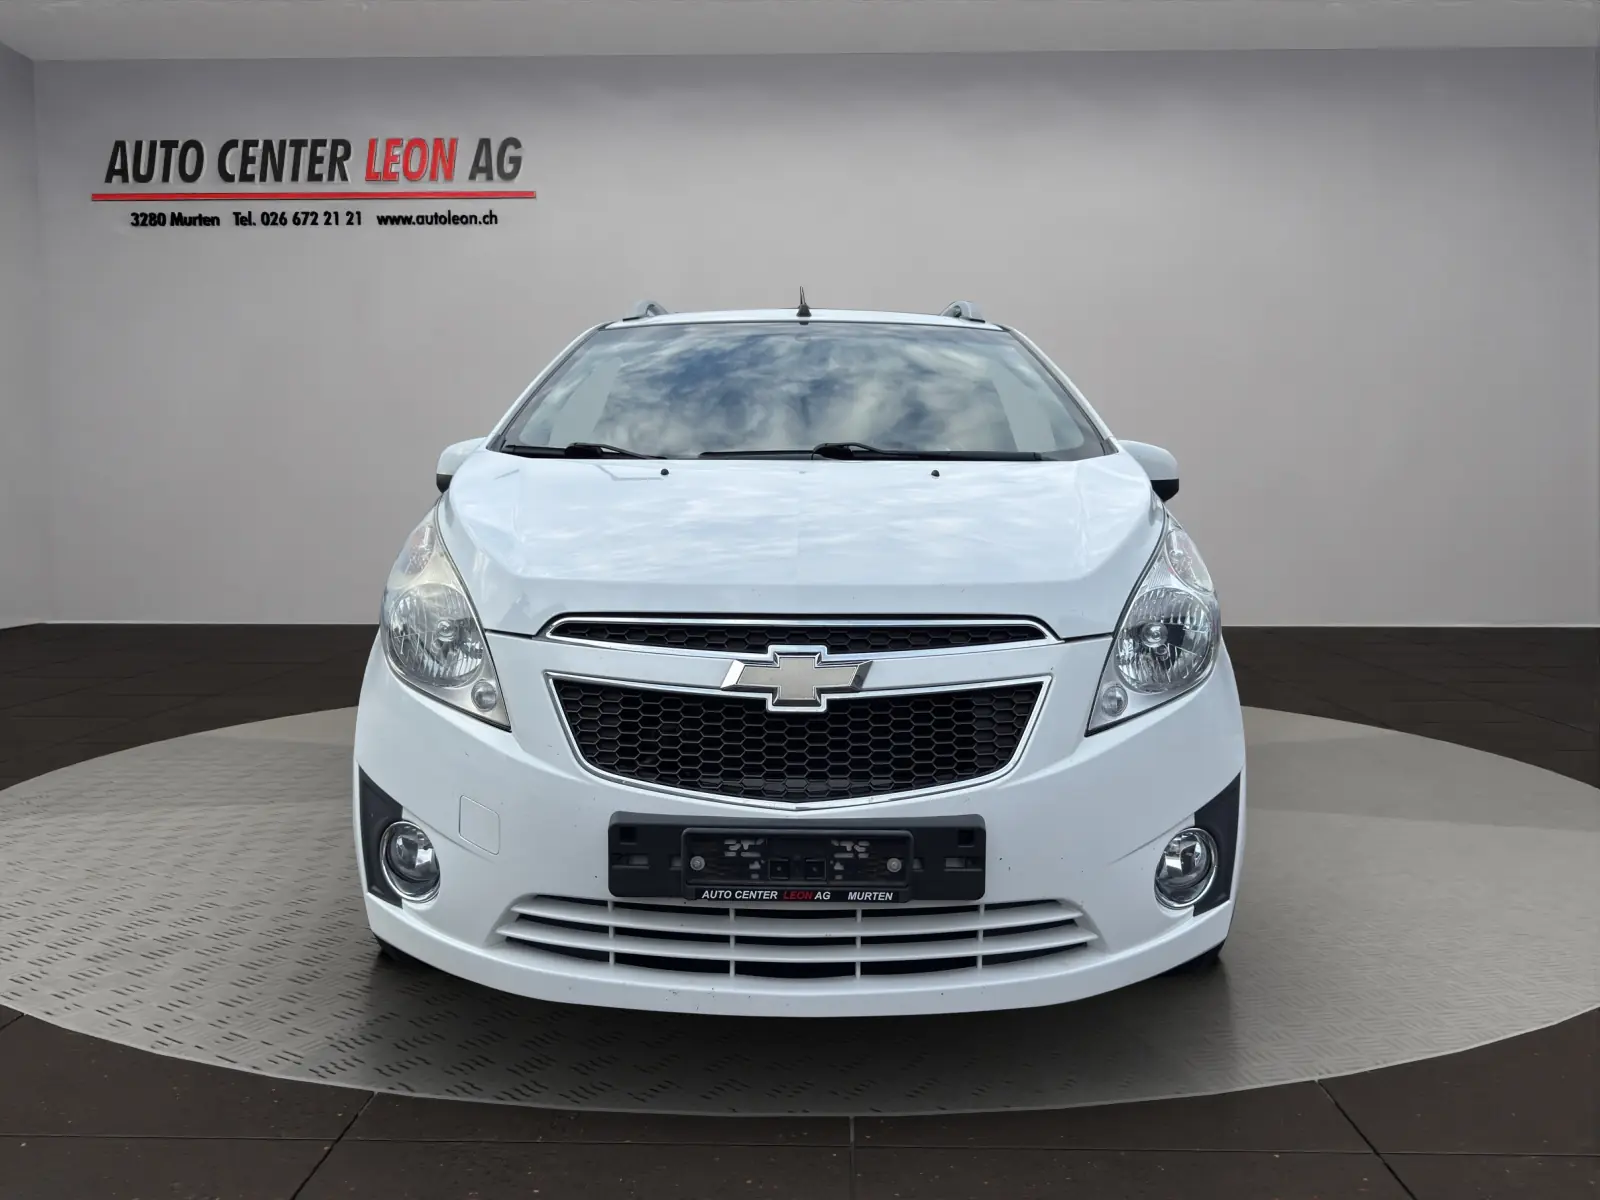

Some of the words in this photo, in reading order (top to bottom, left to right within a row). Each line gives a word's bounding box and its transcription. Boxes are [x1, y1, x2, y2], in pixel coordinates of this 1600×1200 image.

[105, 139, 202, 183] AUTO
[217, 138, 352, 182] CENTER
[365, 136, 459, 181] LEON
[468, 137, 523, 181] AG
[130, 211, 166, 227] 3280
[170, 212, 220, 227] Murten
[233, 211, 257, 227] Tel.
[261, 211, 288, 226] 026
[292, 211, 320, 226] 672
[324, 211, 341, 226] 21
[346, 211, 362, 226] 21
[377, 210, 498, 226] www.autoleon.ch
[702, 890, 733, 900] AUTO
[735, 890, 778, 900] CENTER
[783, 890, 813, 900] LEON
[814, 891, 831, 901] AG
[848, 891, 893, 901] MURTEN
